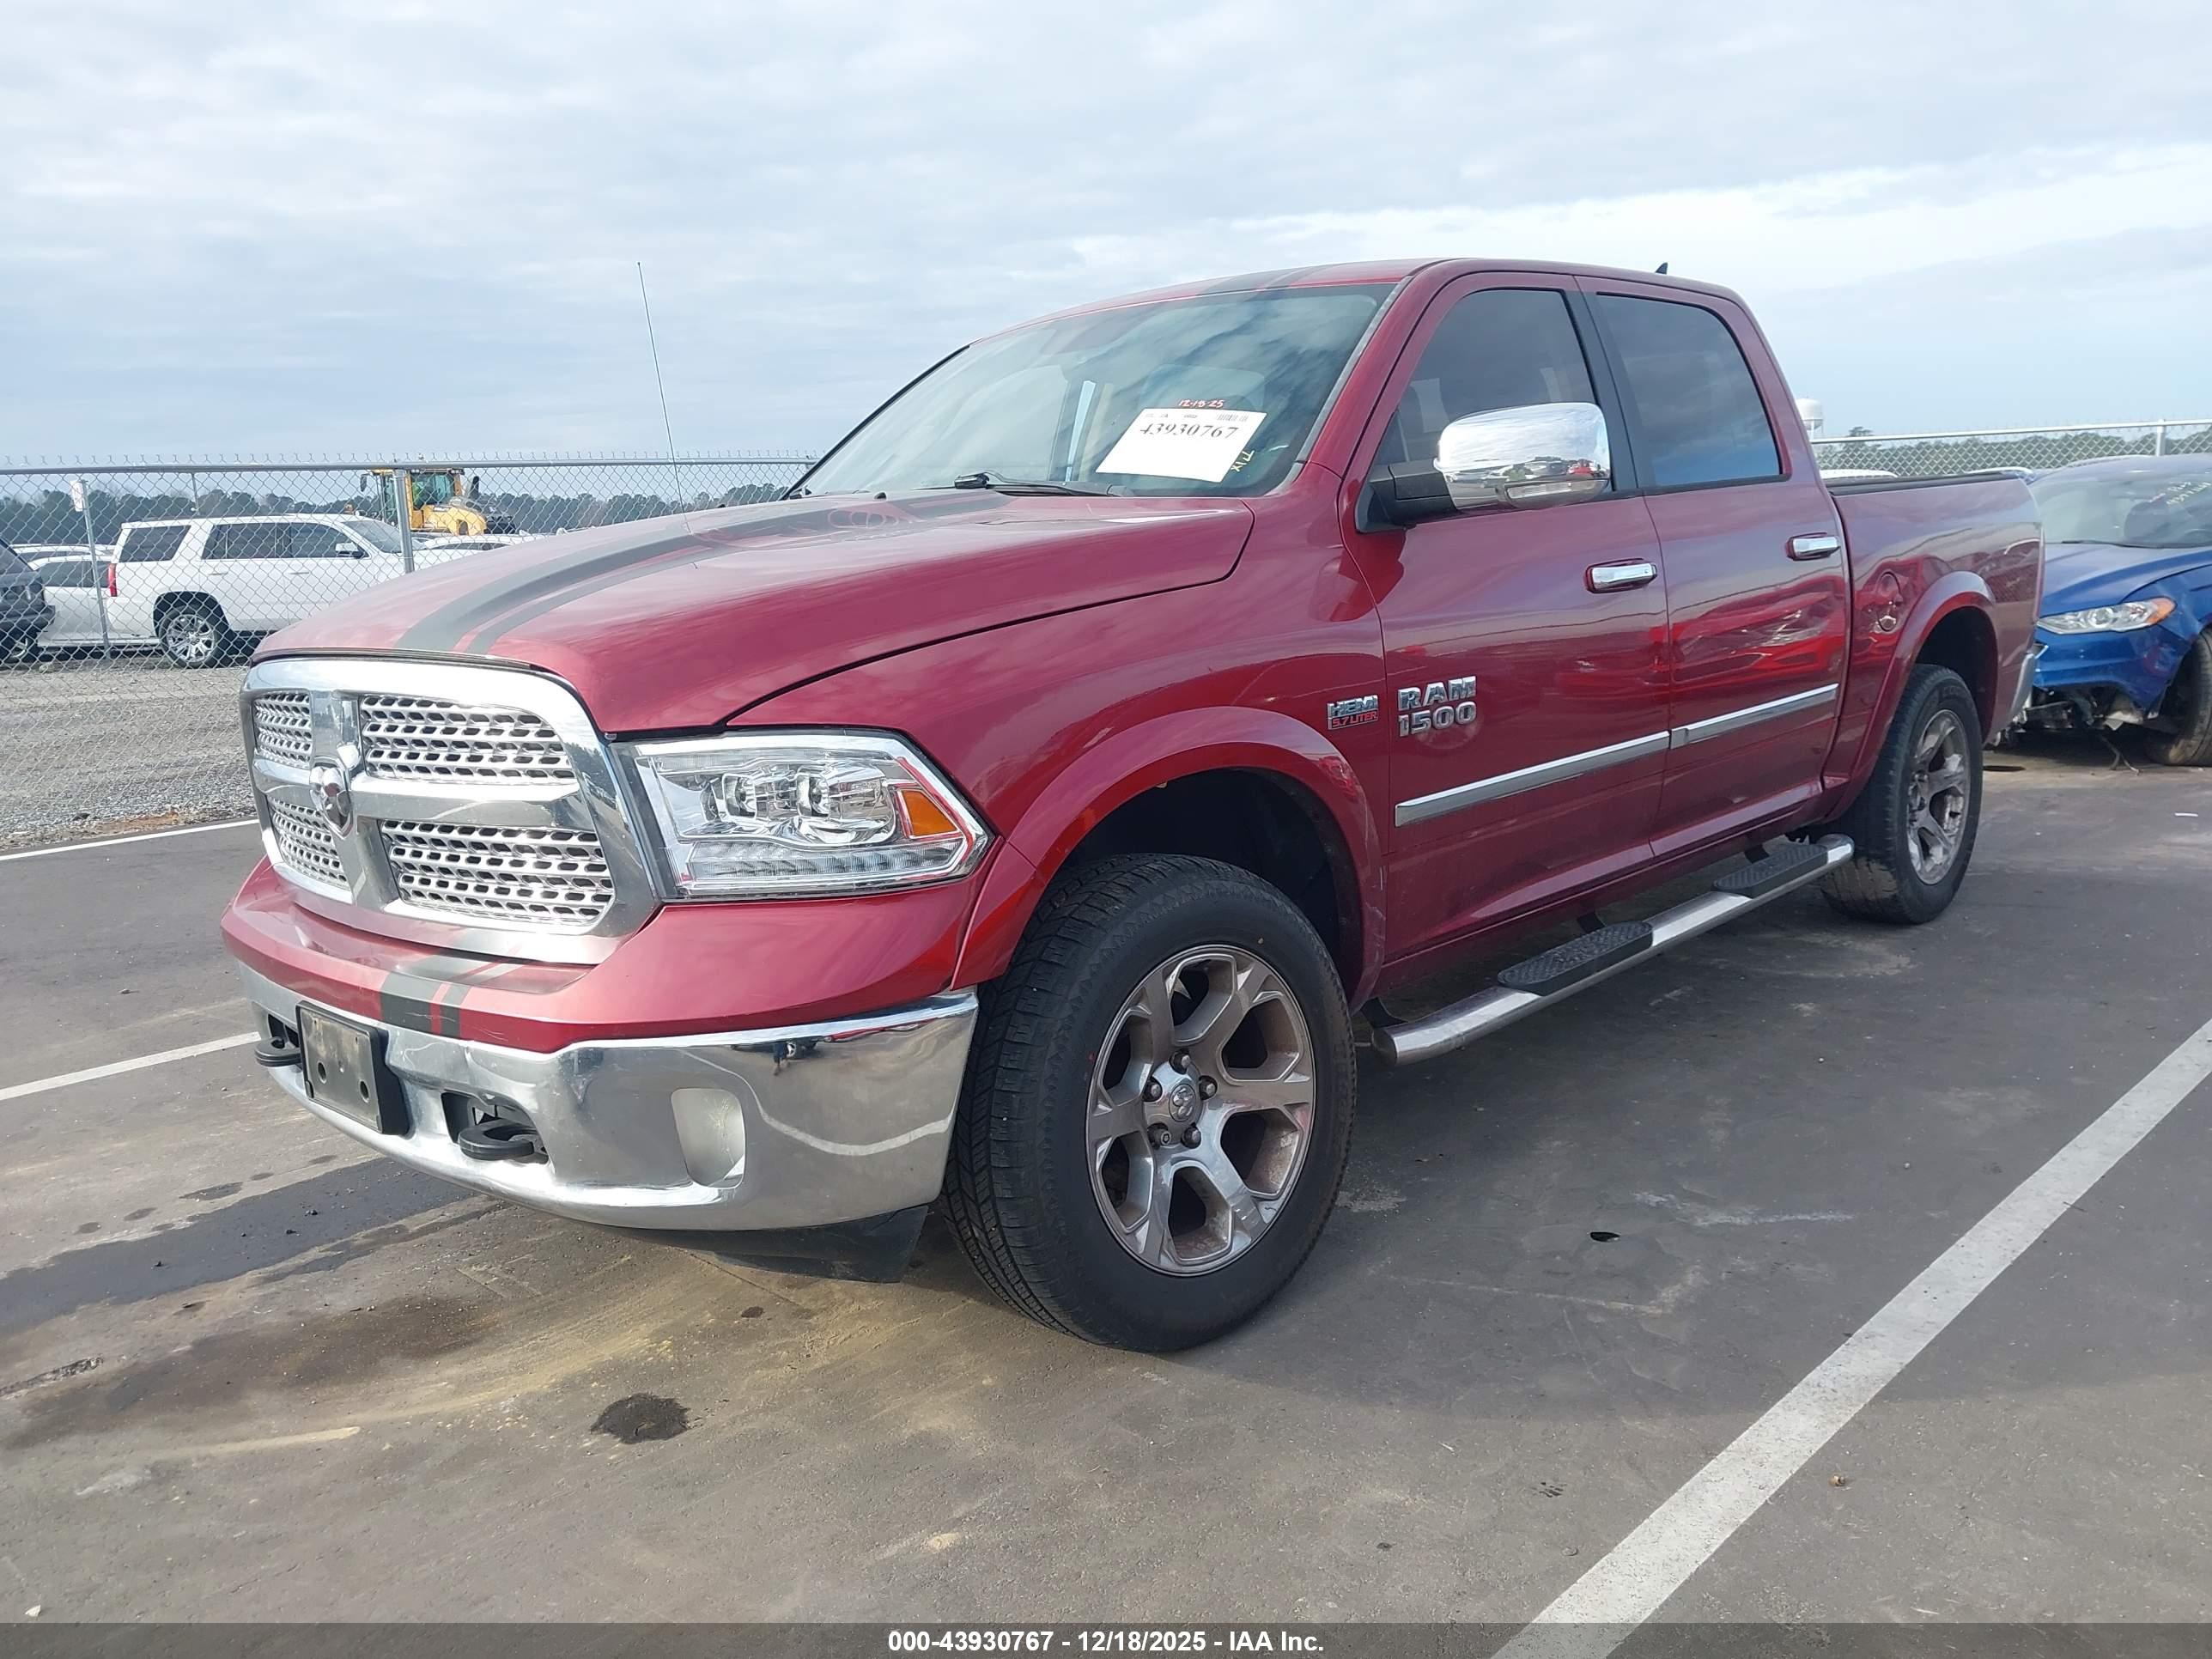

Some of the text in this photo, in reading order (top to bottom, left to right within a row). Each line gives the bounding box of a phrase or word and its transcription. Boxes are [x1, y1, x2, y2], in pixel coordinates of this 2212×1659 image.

[1140, 422, 1239, 439] 43930767
[1398, 676, 1476, 711] RAM
[1327, 695, 1378, 719] HEMI
[1398, 701, 1476, 737] 1500
[1333, 711, 1377, 728] 5.7 LITER
